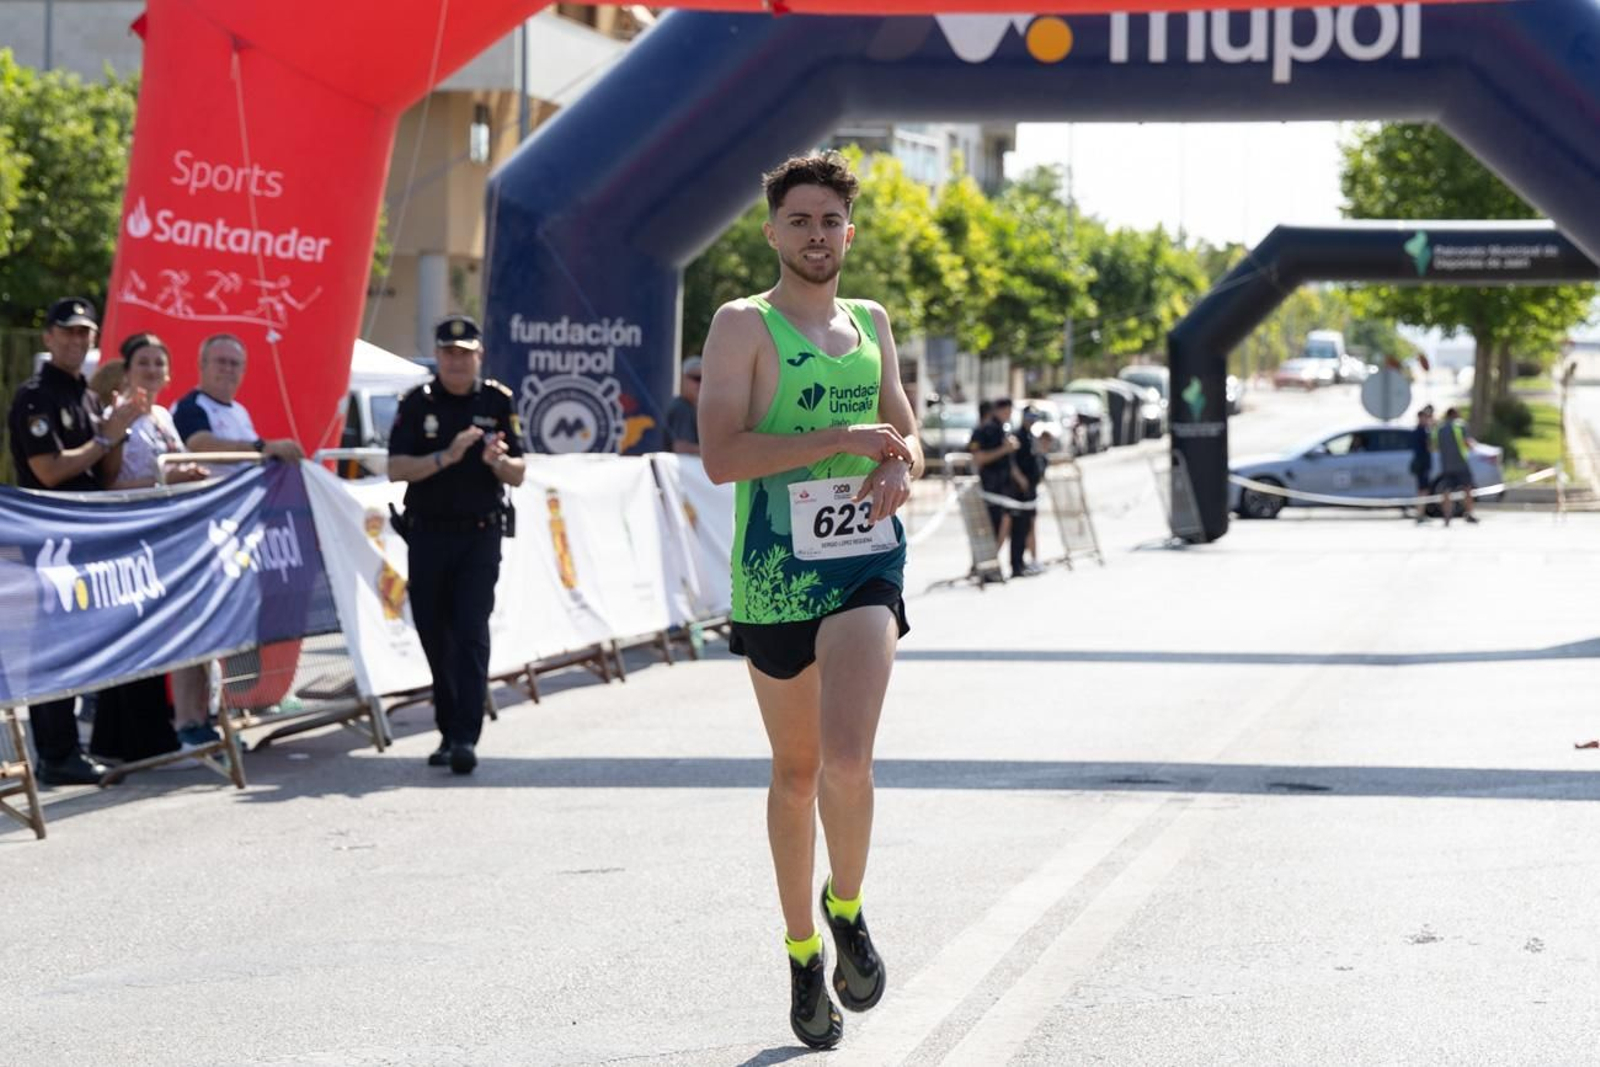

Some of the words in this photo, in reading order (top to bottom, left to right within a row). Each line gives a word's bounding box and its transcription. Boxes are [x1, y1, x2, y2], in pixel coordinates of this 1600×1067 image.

[1109, 3, 1421, 82] mupol
[170, 149, 285, 198] Sports
[153, 208, 332, 263] Santander
[510, 313, 642, 347] fundación
[528, 347, 615, 379] mupol
[829, 397, 873, 413] Unicaja
[813, 501, 875, 539] 623
[84, 539, 166, 617] mupol
